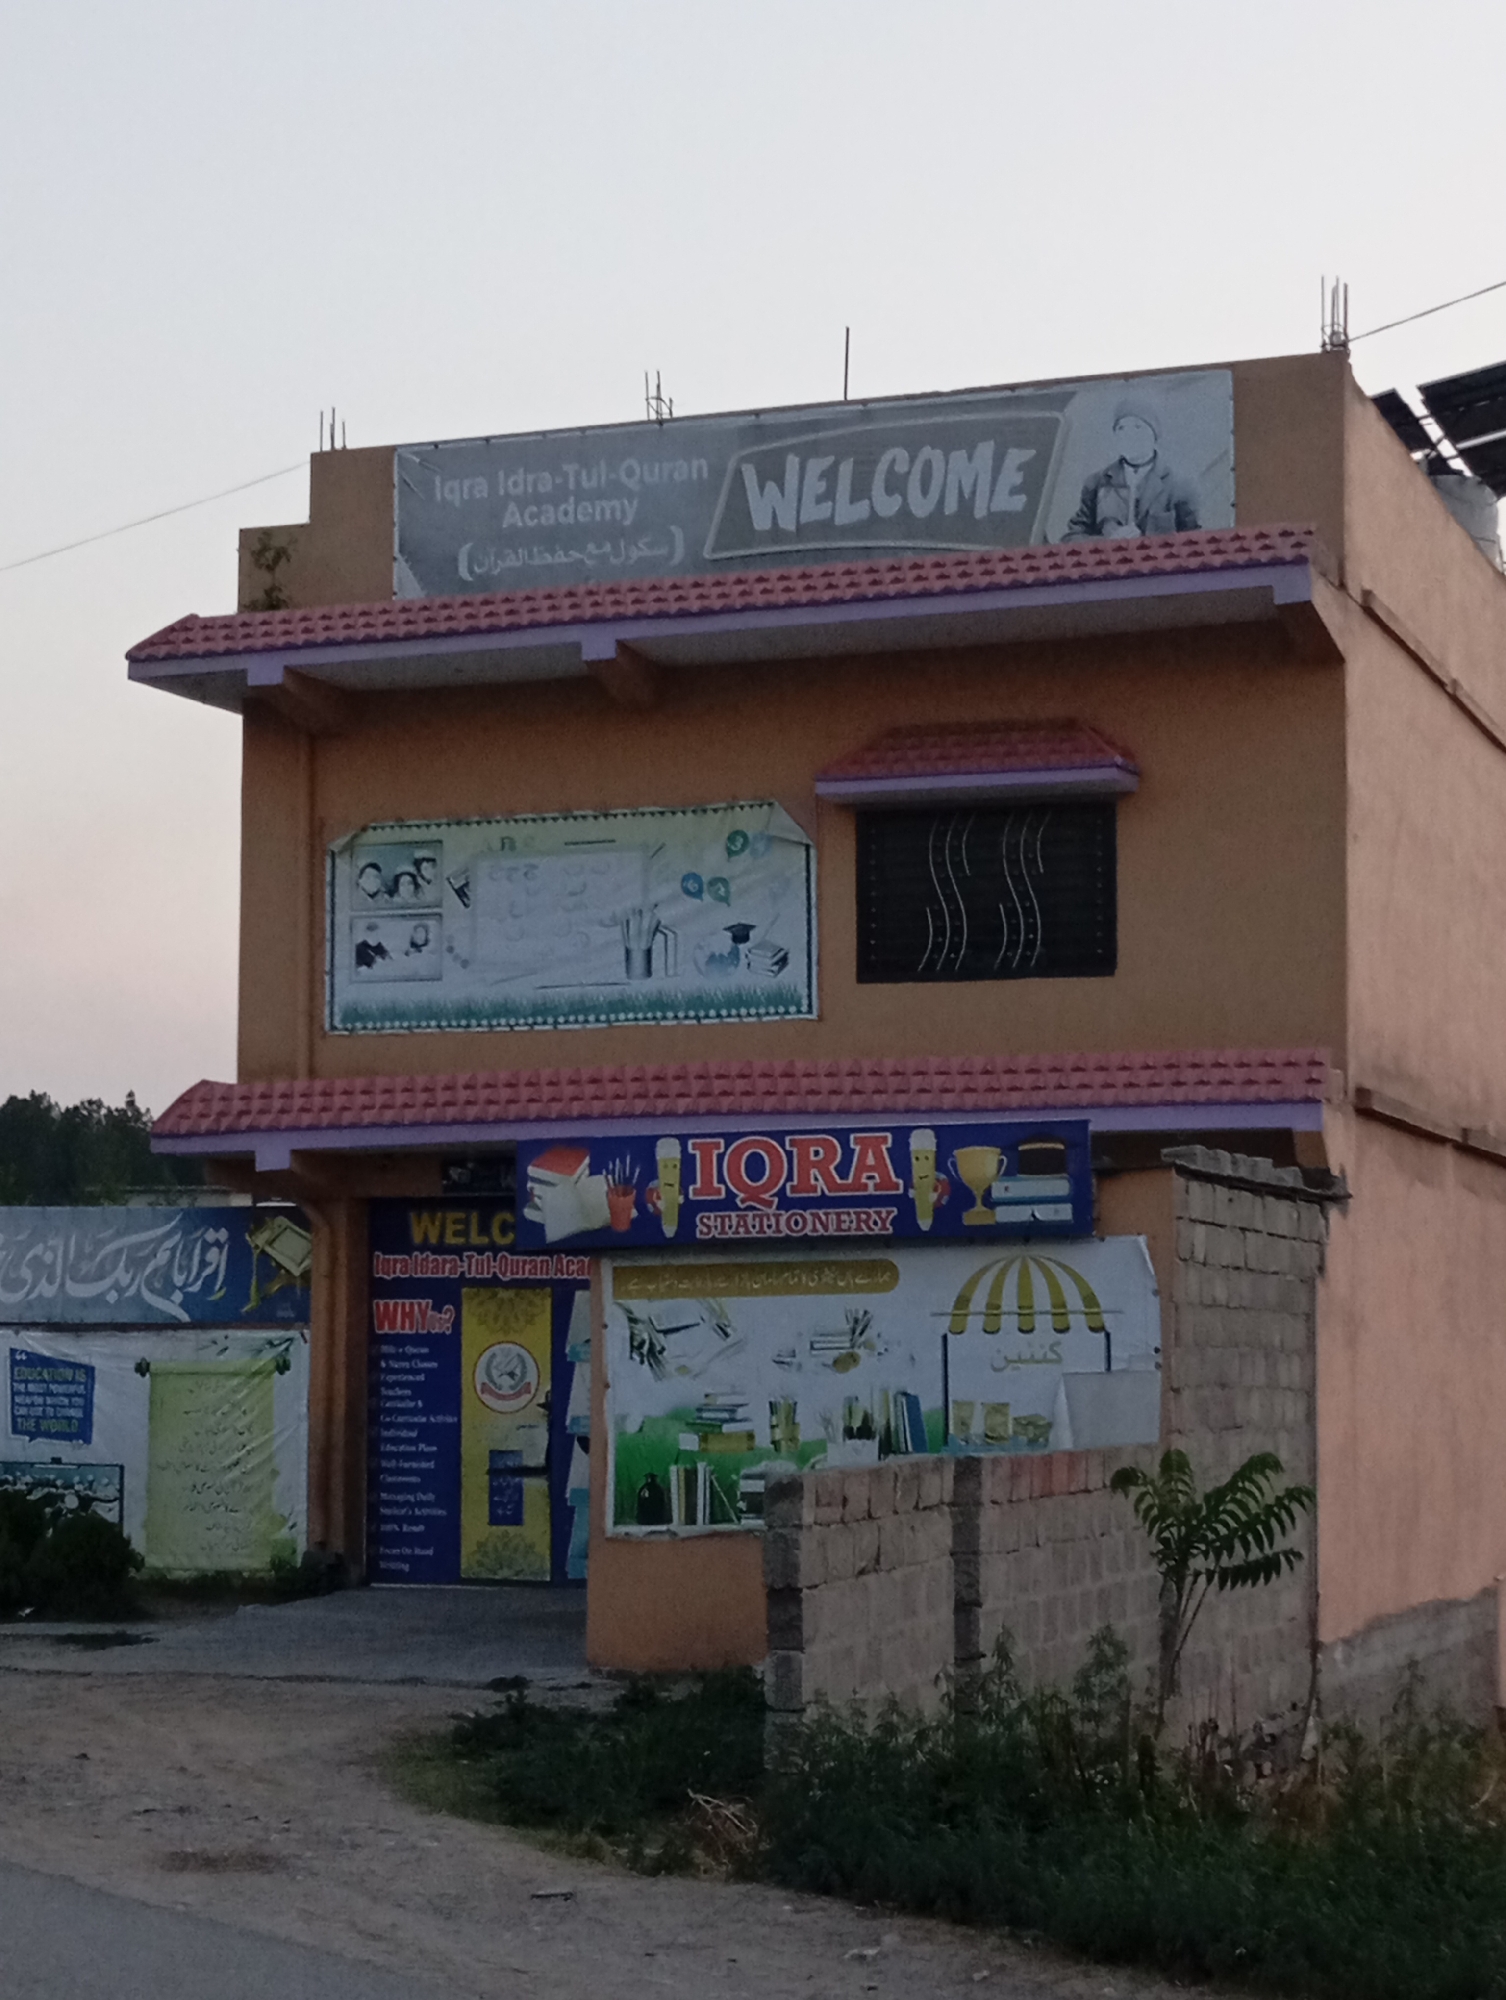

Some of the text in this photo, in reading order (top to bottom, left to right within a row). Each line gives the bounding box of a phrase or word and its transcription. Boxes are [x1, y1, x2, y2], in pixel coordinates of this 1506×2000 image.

[434, 474, 489, 508] Iqra
[741, 440, 1036, 533] WELCOME
[502, 496, 639, 528] Academy
[688, 1132, 905, 1211] IQRA
[696, 1207, 899, 1239] STATIONERY
[374, 1252, 413, 1281] Iqra
[373, 1299, 433, 1334] WHY
